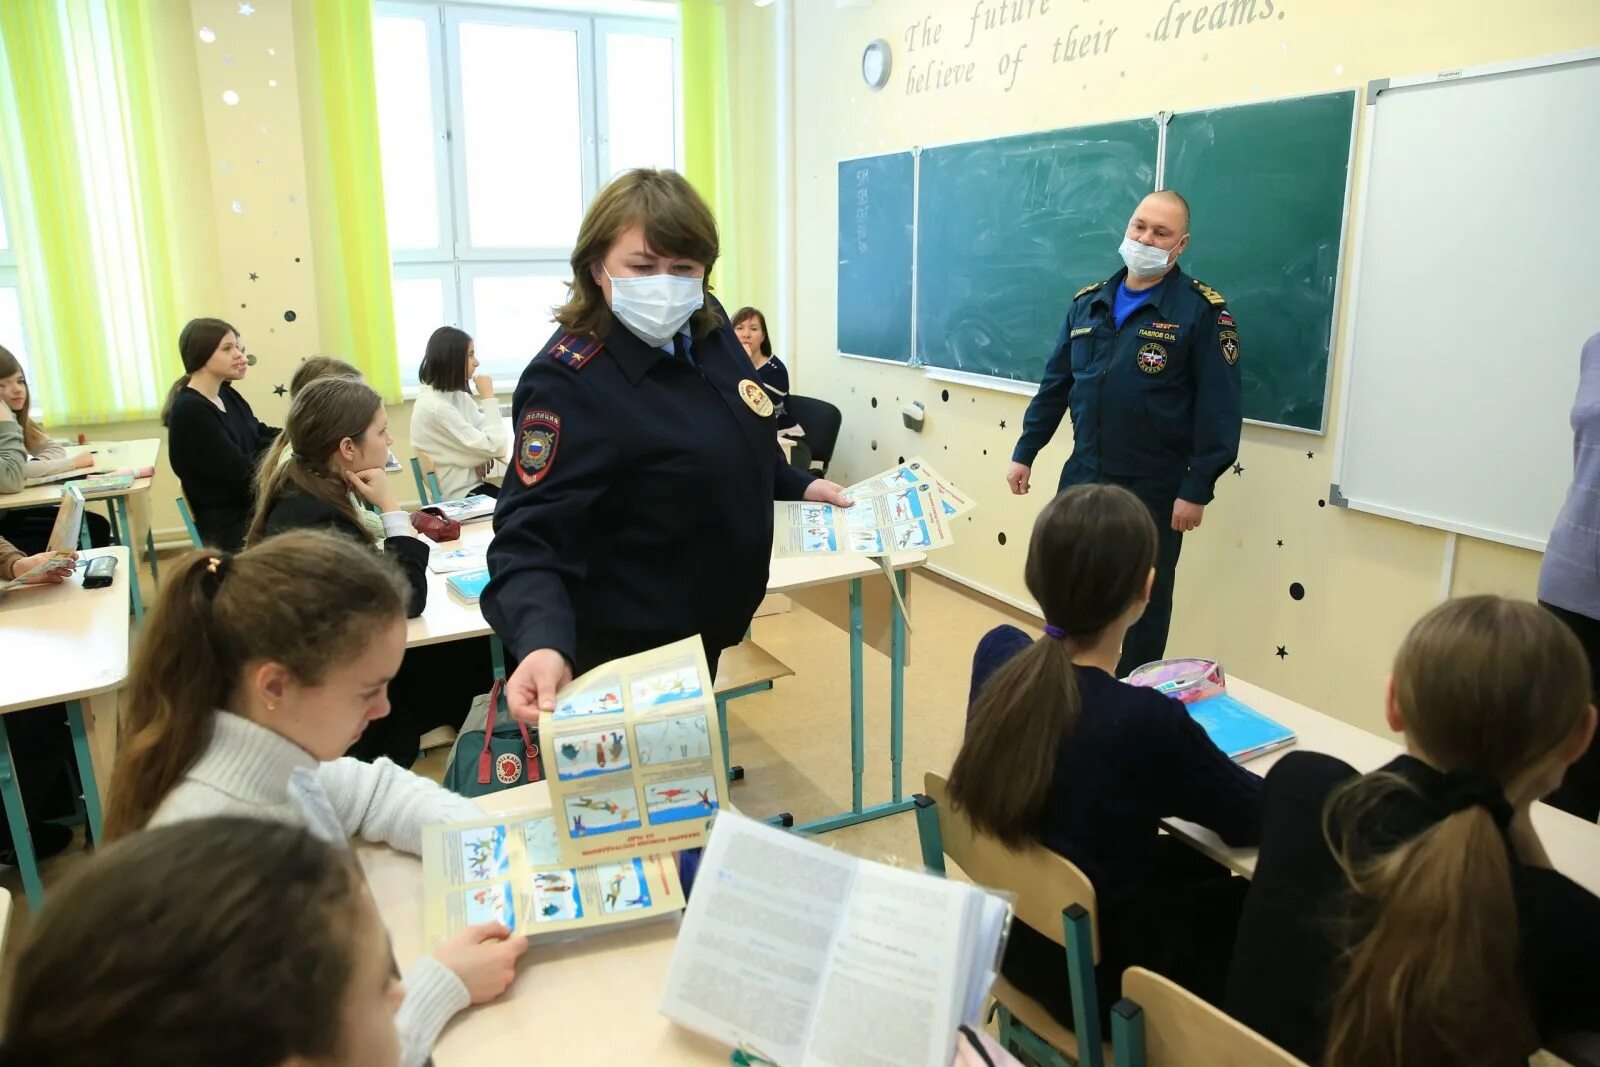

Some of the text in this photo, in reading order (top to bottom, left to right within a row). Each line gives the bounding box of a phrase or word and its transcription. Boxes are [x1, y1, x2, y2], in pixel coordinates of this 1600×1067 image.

[904, 0, 1050, 52] The future
[906, 0, 1285, 95] believe of their dreams.
[1138, 329, 1164, 339] ПАВЛОВ
[526, 412, 559, 425] ПОЛИЦИЯ
